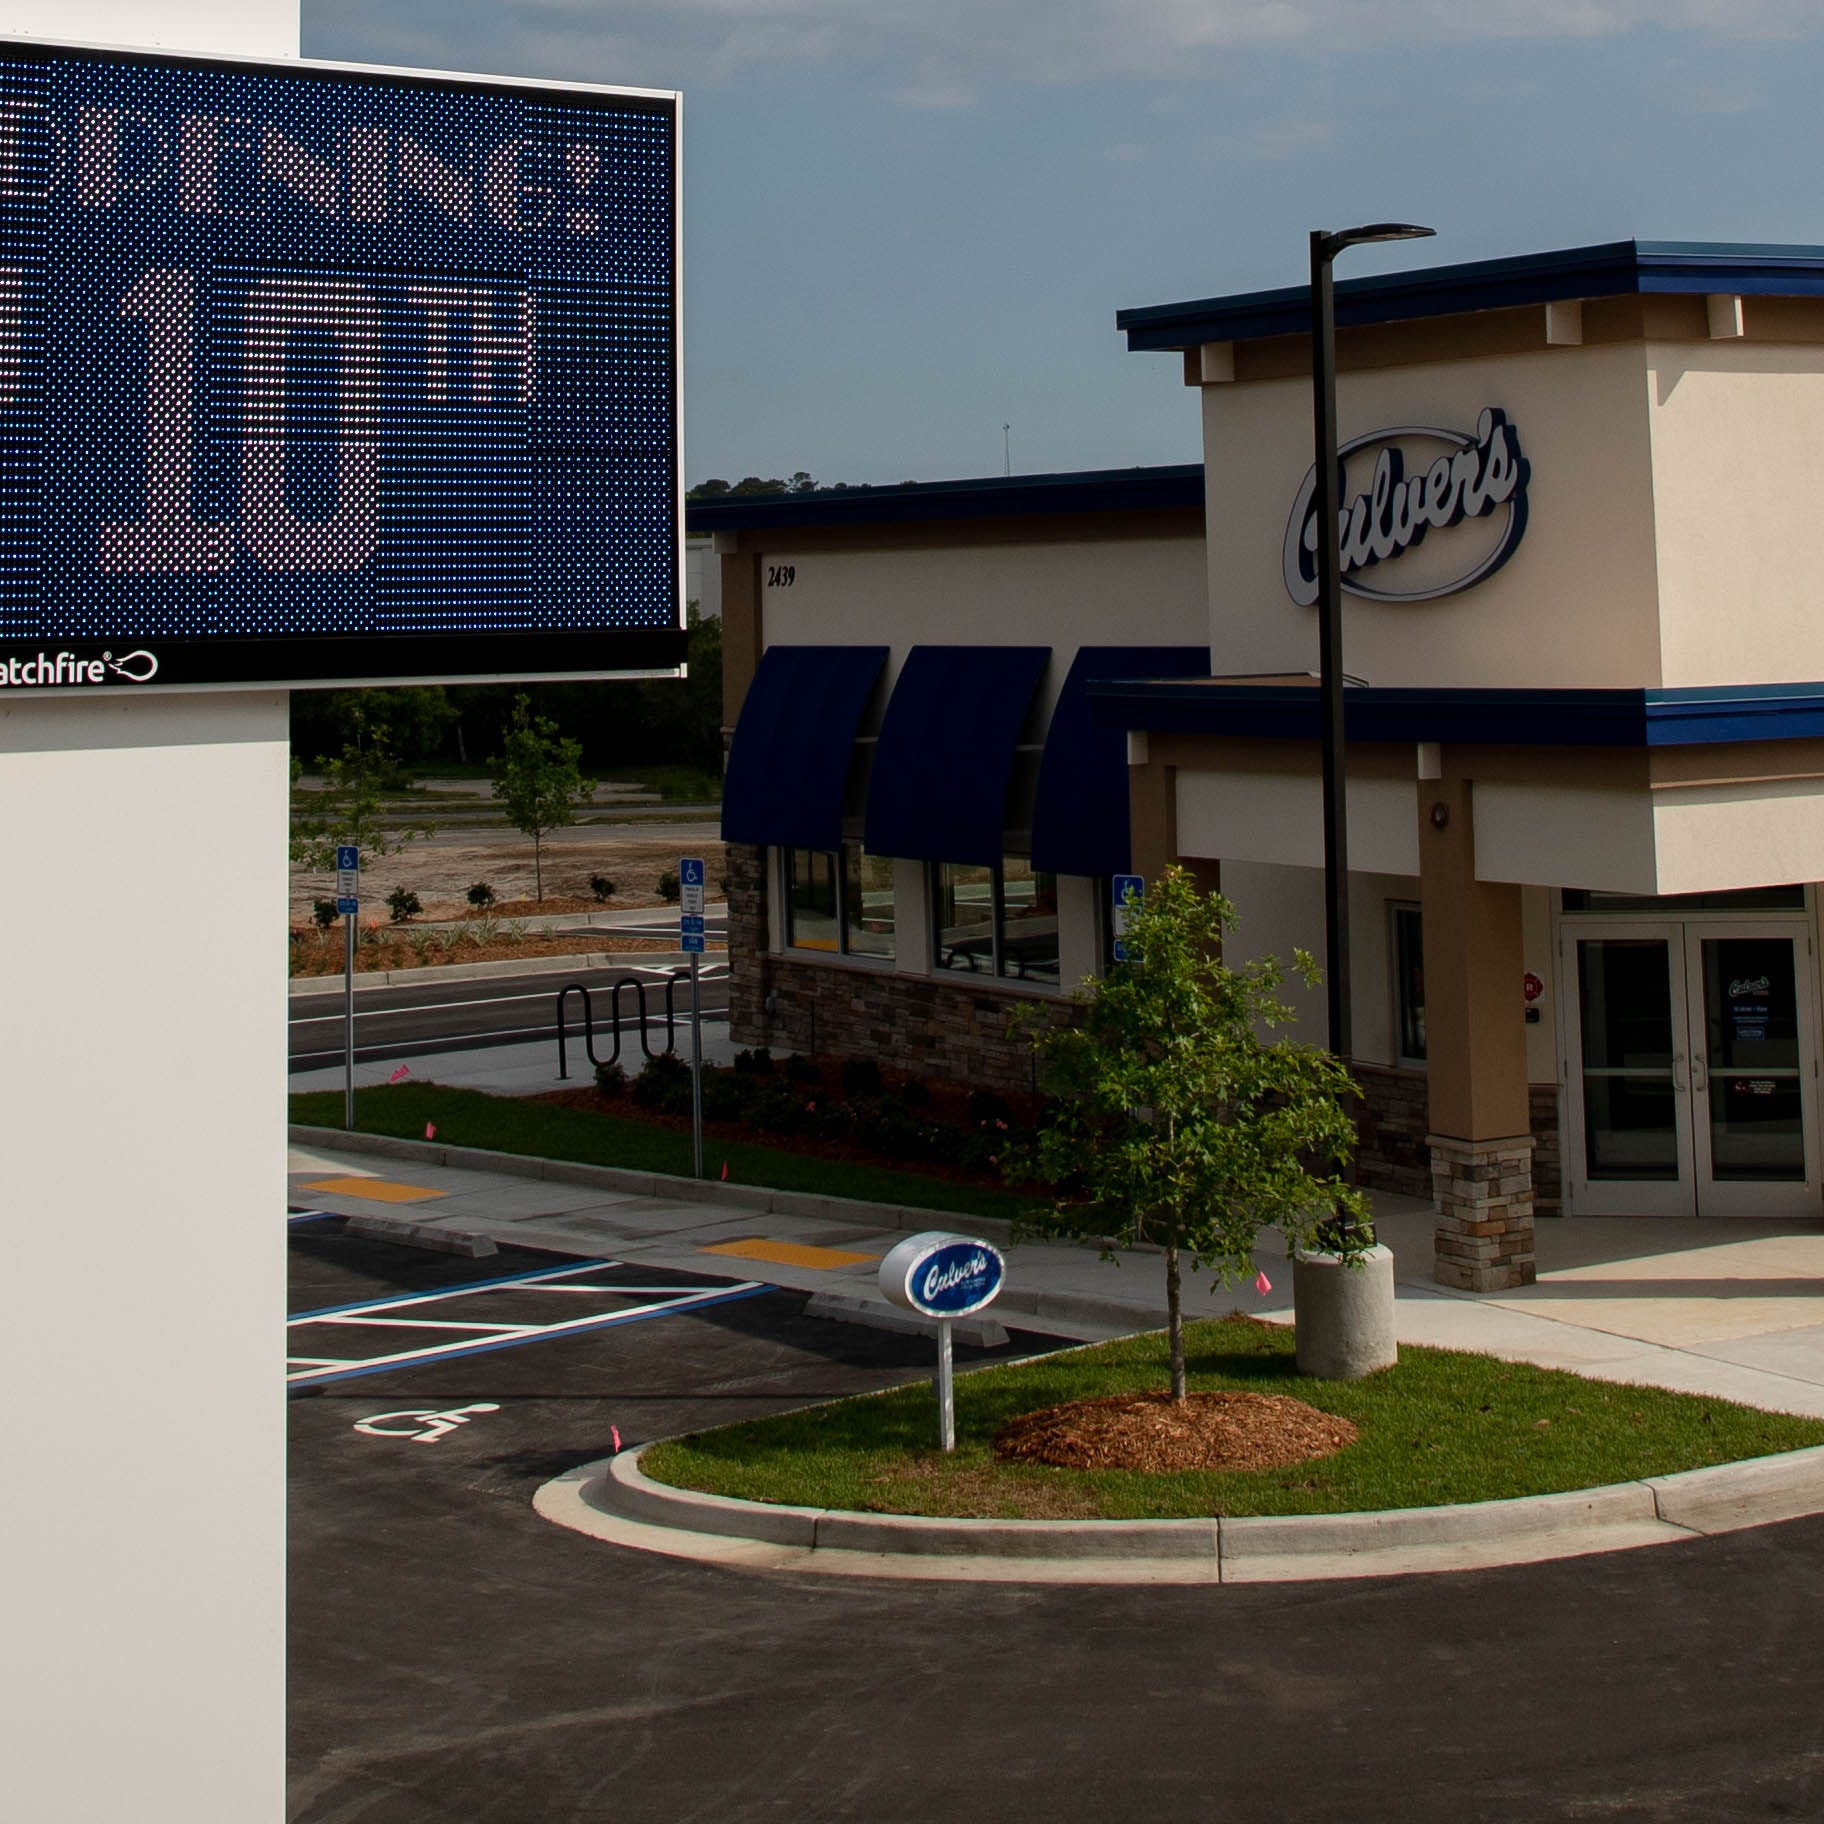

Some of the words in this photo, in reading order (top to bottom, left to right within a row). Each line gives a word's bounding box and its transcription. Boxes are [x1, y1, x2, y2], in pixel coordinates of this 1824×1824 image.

[1281, 407, 1521, 607] Culver's
[767, 565, 795, 587] 2439
[924, 1250, 987, 1300] Culver's
